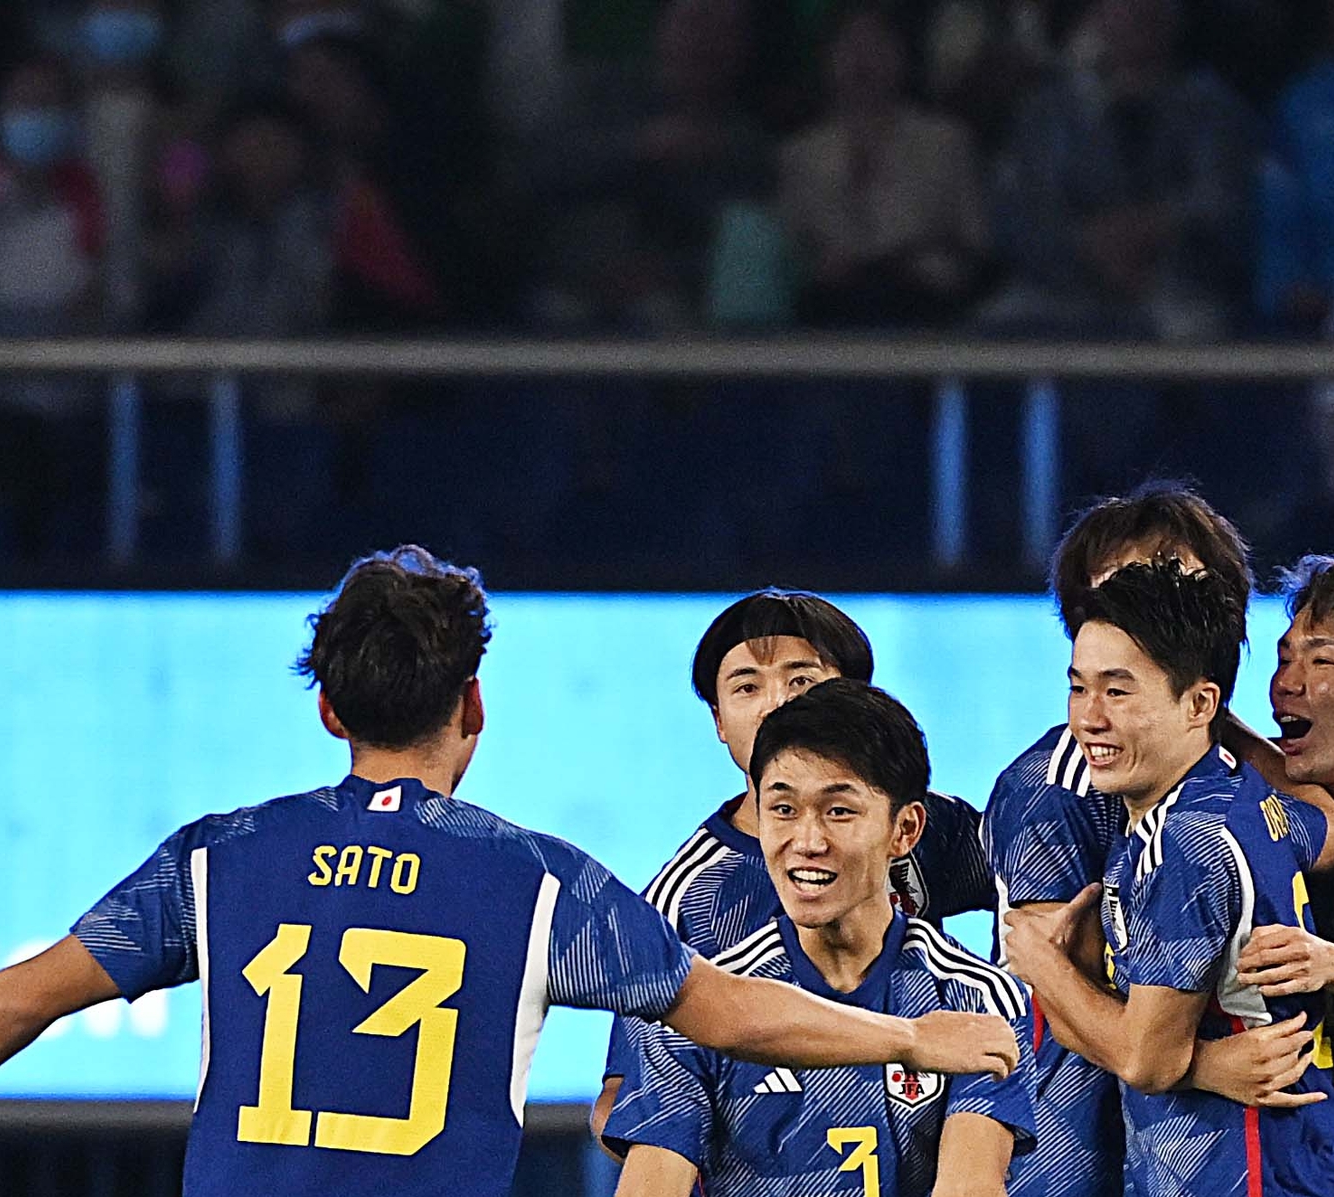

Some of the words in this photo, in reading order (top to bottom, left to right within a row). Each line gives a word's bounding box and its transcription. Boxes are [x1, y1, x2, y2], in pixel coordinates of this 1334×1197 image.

[307, 845, 420, 895] SATO
[236, 923, 466, 1156] 13
[897, 1083, 925, 1096] JFA
